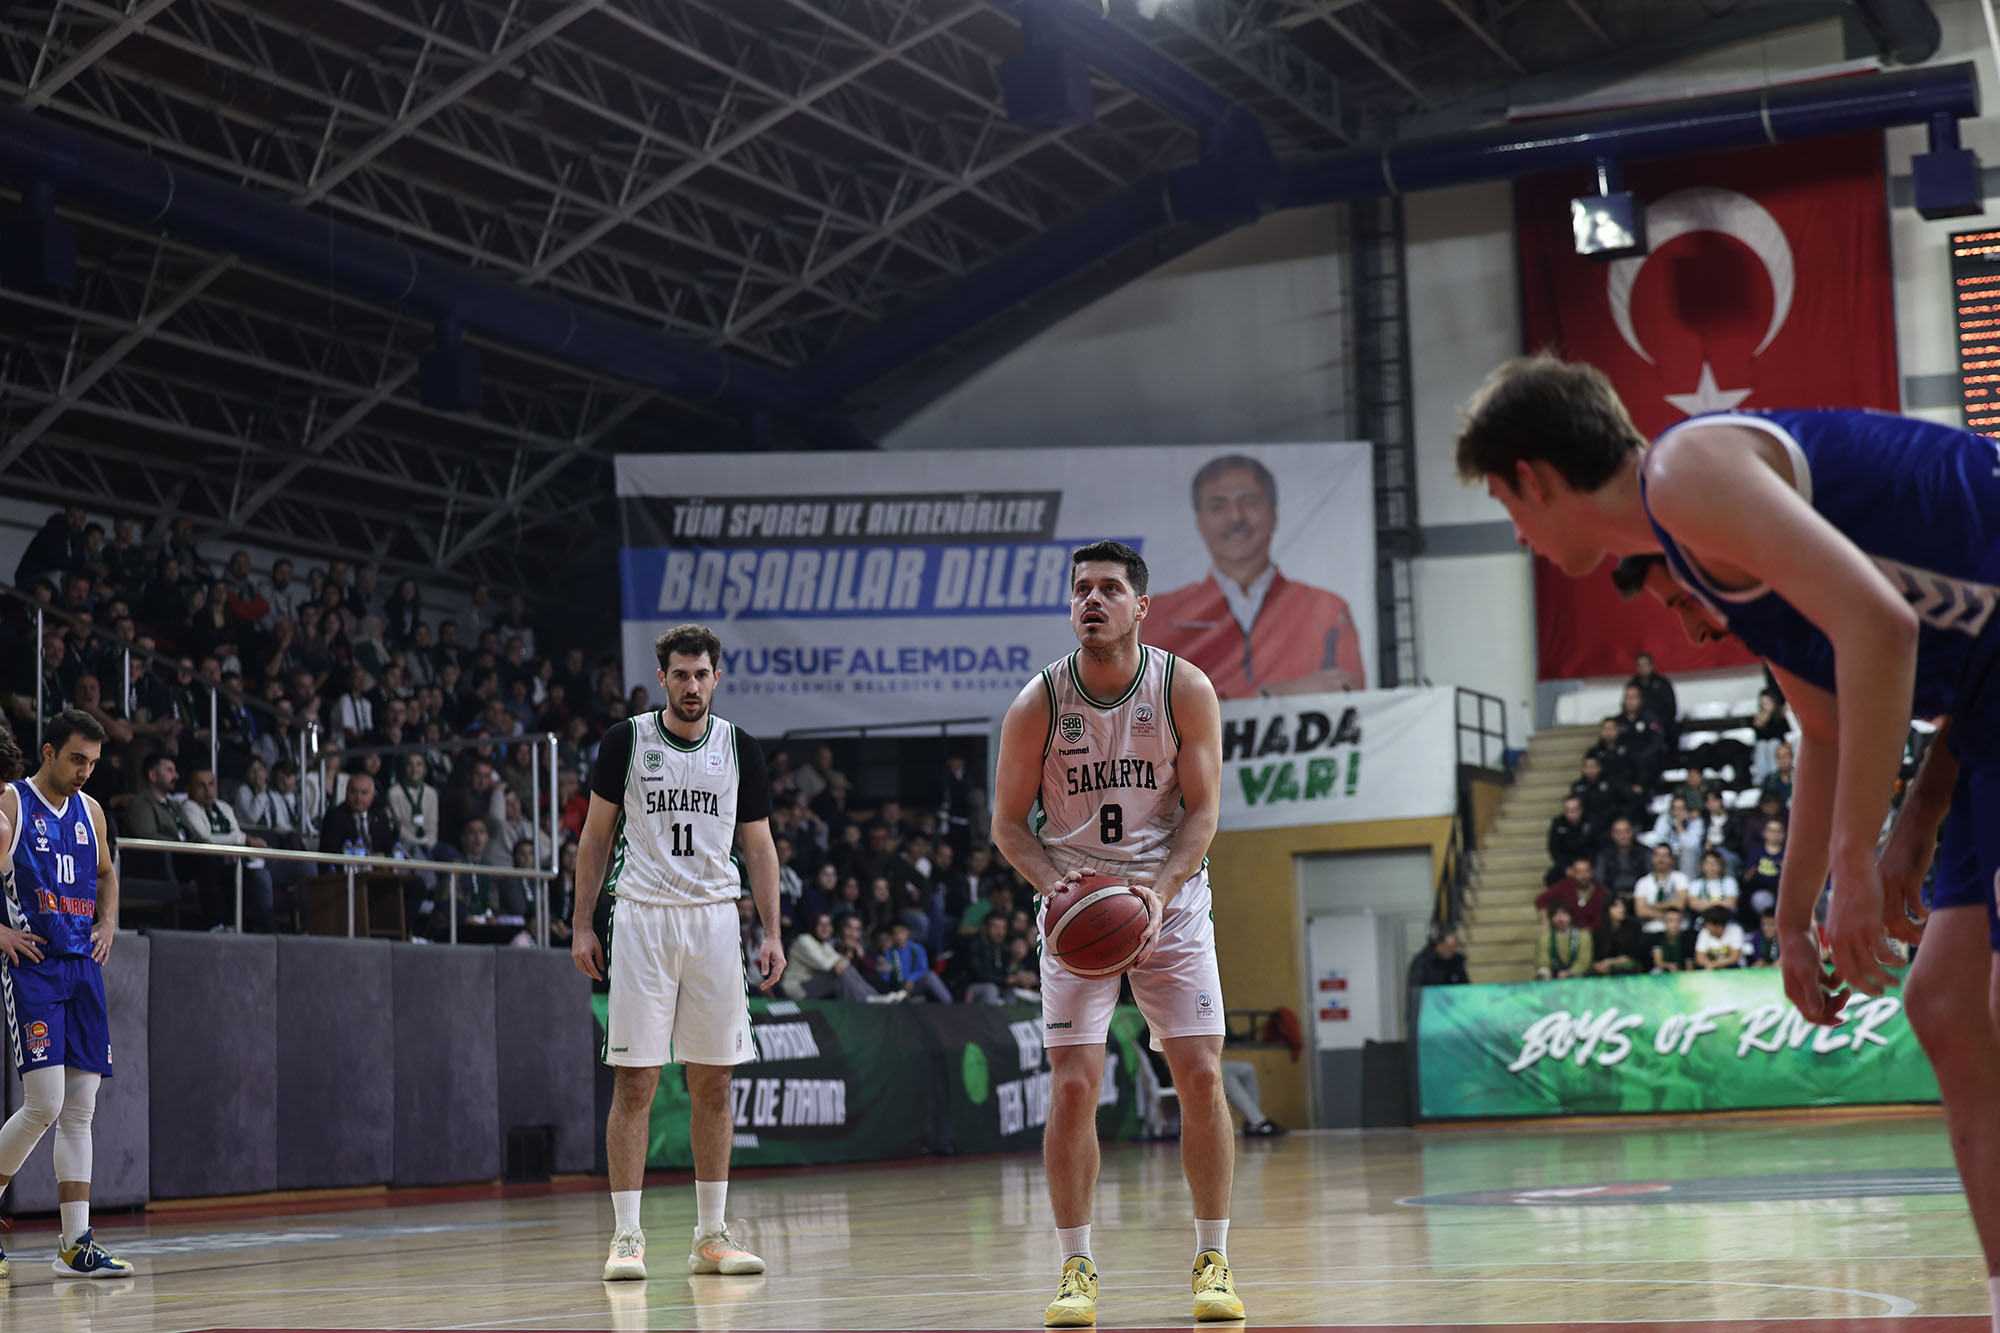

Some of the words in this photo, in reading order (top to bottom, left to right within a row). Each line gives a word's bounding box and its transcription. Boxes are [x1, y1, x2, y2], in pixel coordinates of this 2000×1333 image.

[673, 498, 725, 537] TÜM
[727, 503, 829, 537] SPORCU
[833, 502, 864, 536] VE
[865, 493, 1049, 536] ANTRENÖRLERE
[658, 549, 927, 623] BAŞARILAR
[1062, 717, 1082, 730] SBB
[1059, 746, 1089, 756] hummel
[1066, 759, 1158, 797] SAKARYA
[1238, 751, 1362, 807] VAR!
[646, 789, 719, 818] SAKARYA
[671, 823, 695, 857] 11
[1100, 803, 1123, 845] 8
[56, 852, 75, 885] 10
[60, 896, 95, 919] BURGR
[1507, 1007, 1645, 1073] BOYS
[1653, 1007, 1736, 1056] OF
